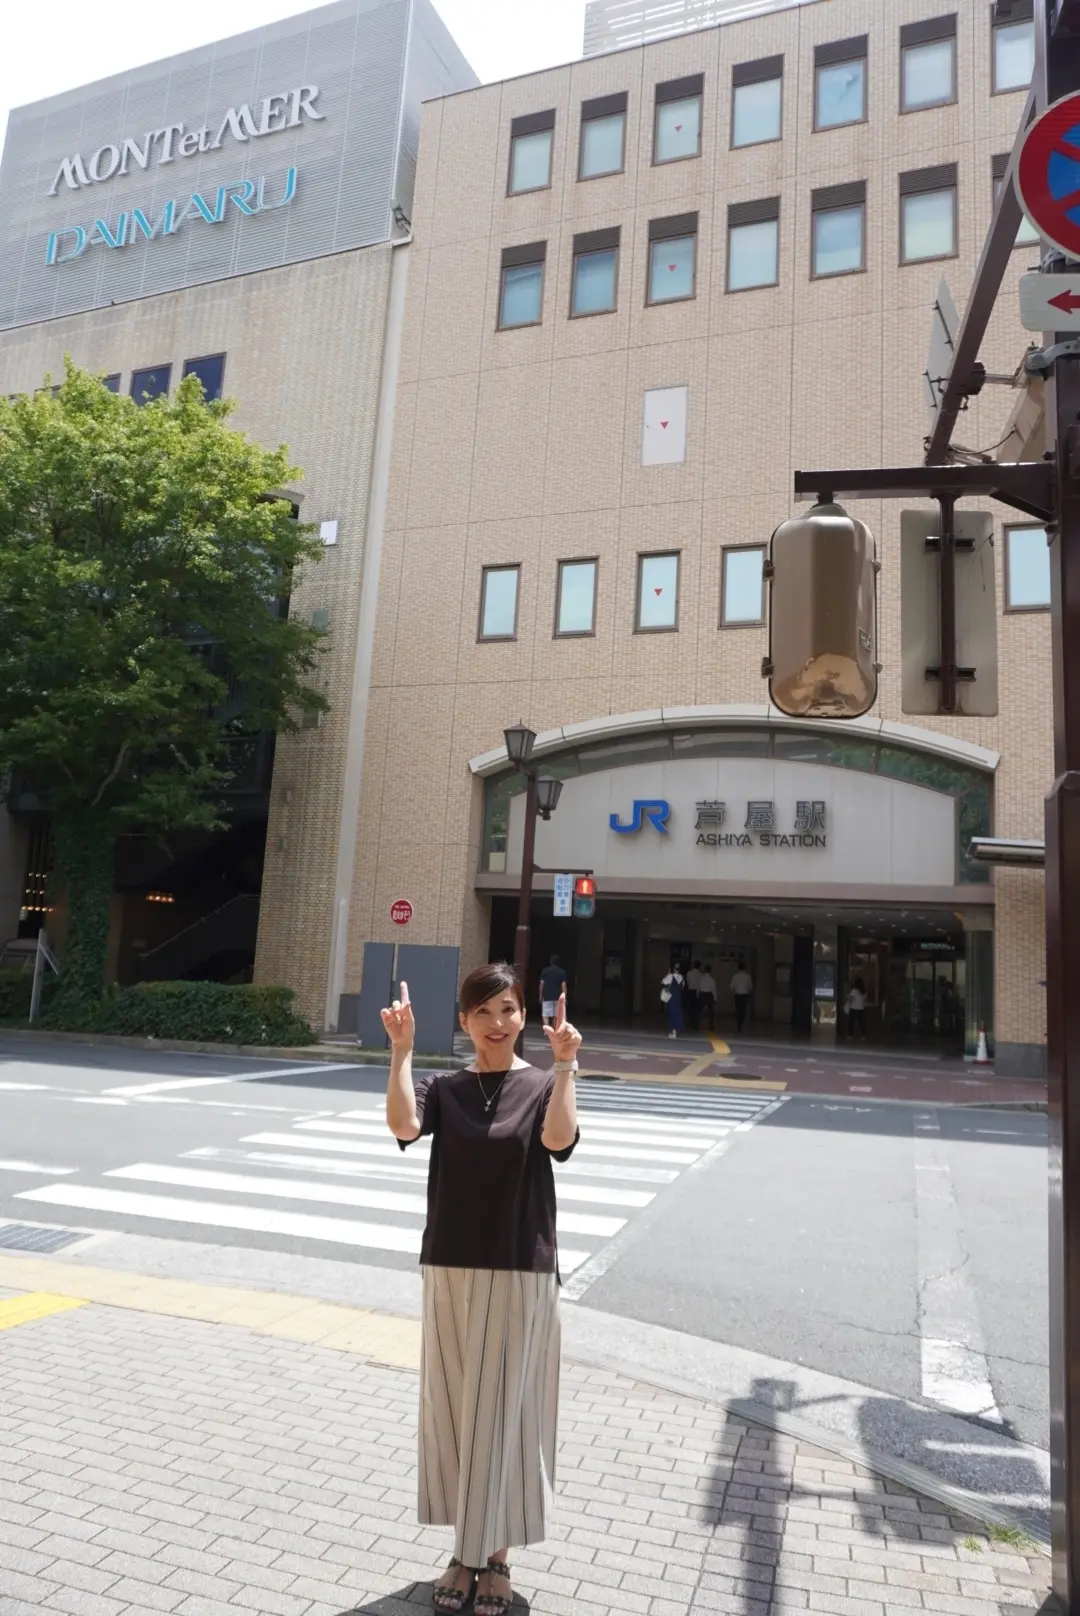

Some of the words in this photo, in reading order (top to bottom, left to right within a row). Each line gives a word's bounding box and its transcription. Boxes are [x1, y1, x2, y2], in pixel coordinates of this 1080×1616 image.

[45, 166, 298, 265] DAIMARU
[609, 799, 671, 834] JR
[694, 800, 826, 832] 芦屋駅
[696, 833, 752, 848] ASHIYA
[759, 833, 826, 848] STATION
